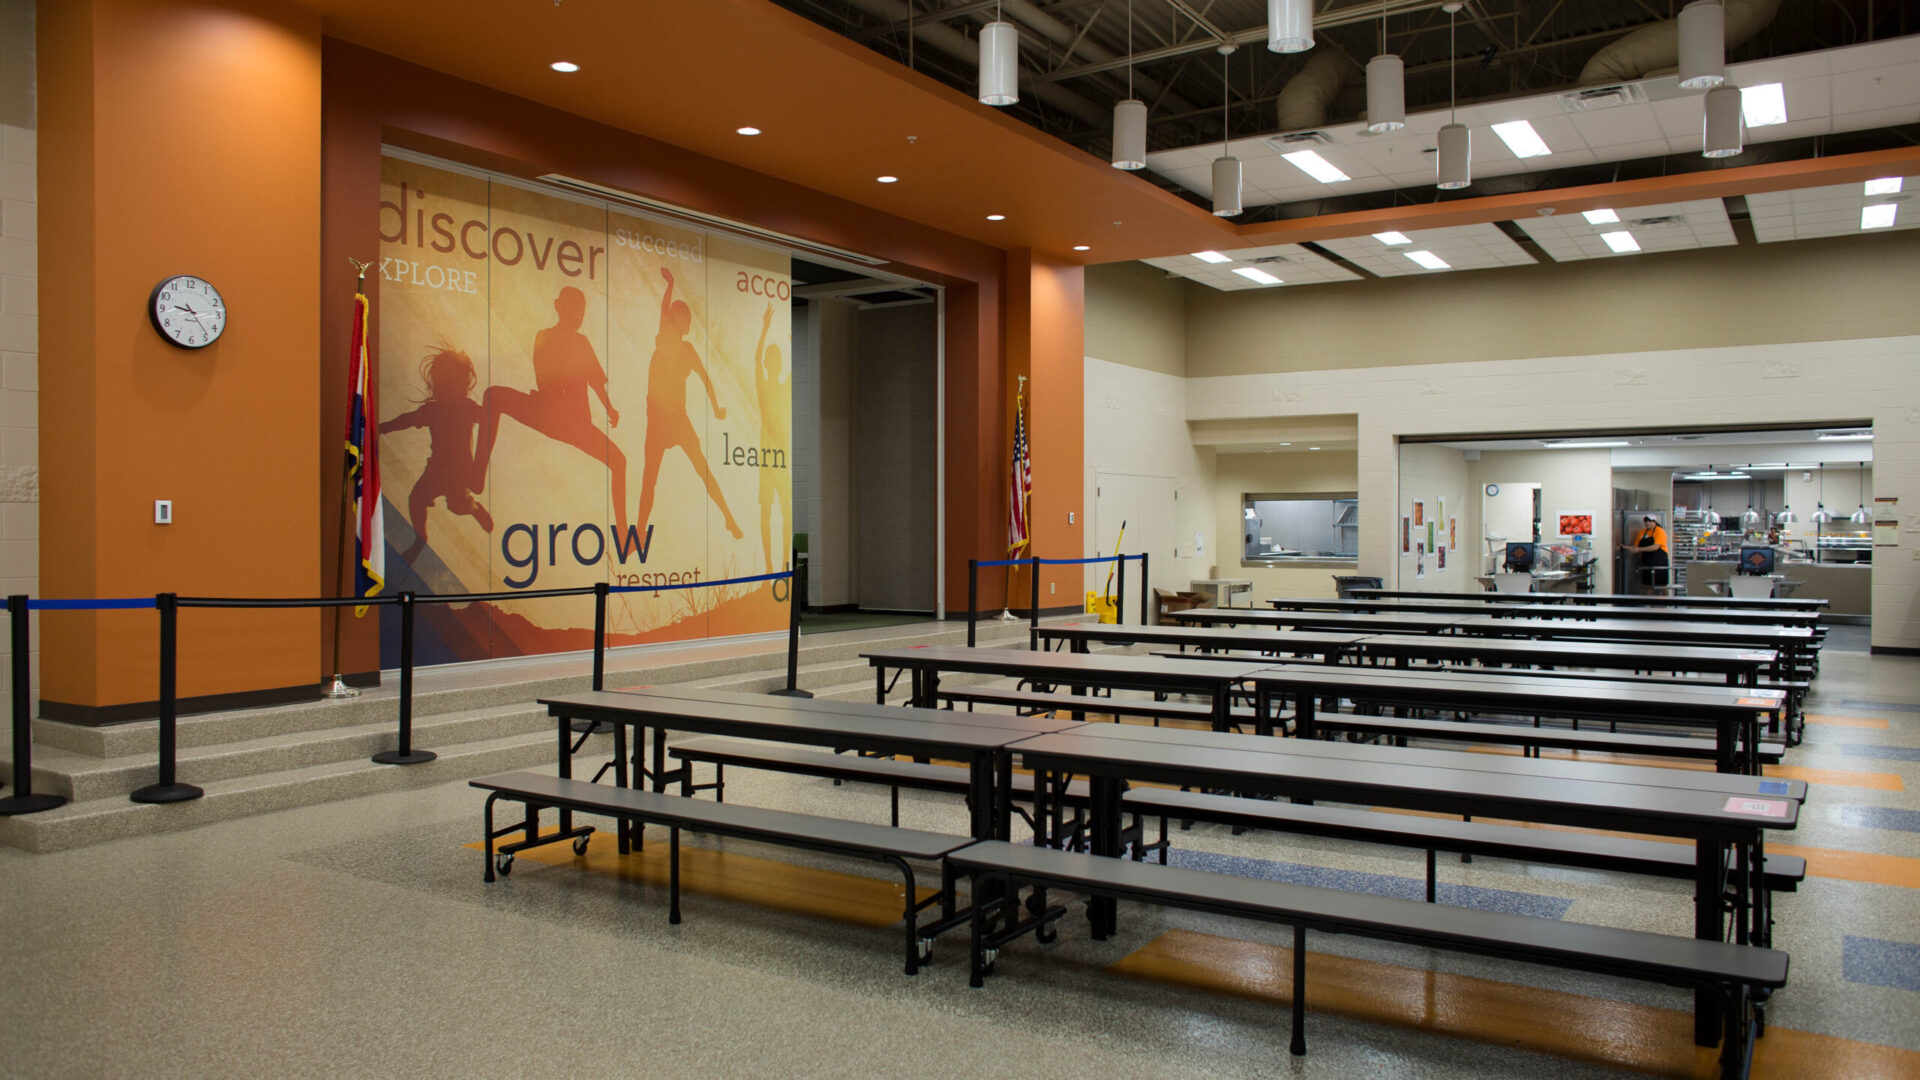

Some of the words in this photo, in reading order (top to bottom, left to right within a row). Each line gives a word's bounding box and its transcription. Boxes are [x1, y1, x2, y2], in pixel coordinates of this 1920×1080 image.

[379, 182, 605, 281] discover
[615, 228, 704, 264] succeed
[171, 282, 178, 291] 11
[186, 280, 196, 289] 12
[736, 271, 791, 302] acco
[161, 292, 171, 301] 10
[212, 298, 218, 307] 2
[159, 304, 166, 313] 9
[215, 311, 221, 320] 3
[164, 318, 171, 327] 8
[211, 324, 218, 333] 4
[175, 329, 181, 338] 7
[202, 332, 208, 342] 5
[188, 335, 195, 345] 6
[723, 432, 787, 469] learn
[501, 523, 655, 589] grow
[616, 567, 702, 598] respect
